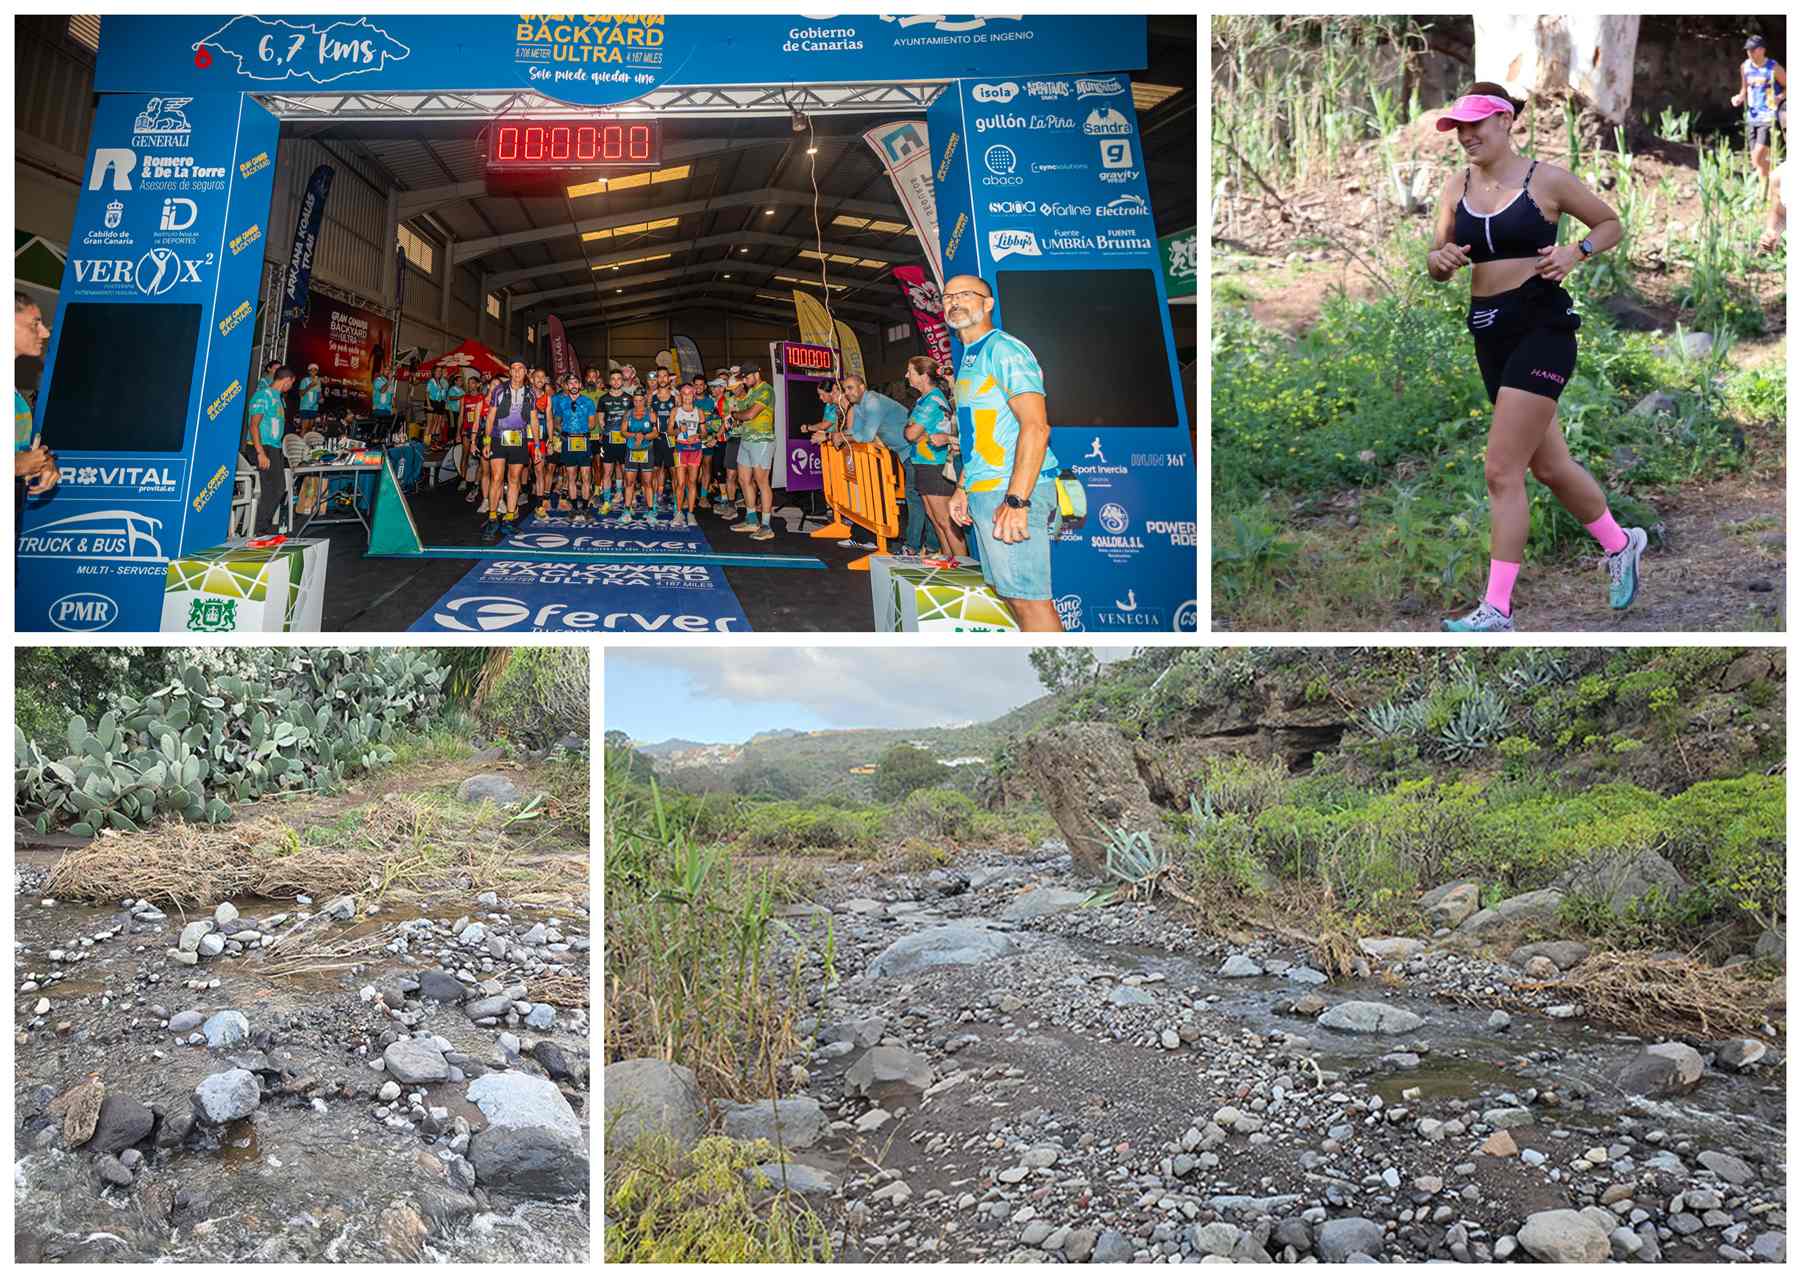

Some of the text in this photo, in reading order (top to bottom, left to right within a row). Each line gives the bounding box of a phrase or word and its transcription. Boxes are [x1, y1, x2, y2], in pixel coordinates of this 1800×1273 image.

[516, 24, 664, 46] BACKYARD
[789, 27, 855, 39] Gobierno
[894, 31, 1033, 47] AYUNTAMIENTO DE INGENIO
[259, 33, 376, 65] 6,7 kms
[783, 39, 863, 51] de Canarias
[553, 44, 623, 63] ULTRA
[643, 53, 663, 64] MILES
[529, 66, 655, 85] Solo puede quedar uno
[980, 86, 1011, 98] isola
[976, 113, 1075, 132] gullón La Piña
[1085, 122, 1132, 134] Sandra
[131, 135, 190, 147] GENERALI
[499, 126, 649, 160] 00:00:00
[143, 156, 194, 167] Romero
[141, 167, 225, 178] & De La Torre
[1099, 170, 1140, 182] gravity
[139, 179, 225, 192] Asesores de seguros
[982, 176, 1023, 185] abaco
[1051, 203, 1091, 216] farline
[1096, 206, 1150, 216] Electrolit
[287, 192, 316, 300] ARKANA KOALAS
[993, 233, 1032, 250] Libby's
[1042, 235, 1095, 250] UMBRÍA
[1096, 235, 1151, 249] Bruma
[57, 467, 176, 485] ROVITAL
[1072, 465, 1128, 475] Sport Inercia
[1146, 521, 1197, 535] POWER
[17, 537, 127, 552] TRUCK & BUS
[573, 536, 701, 549] ferver
[77, 566, 109, 575] MULTI
[117, 566, 168, 576] SERVICES
[493, 561, 708, 574] GRAN CANARIA
[484, 568, 711, 582] BACKYARD
[539, 576, 650, 587] ULTRA
[58, 601, 109, 622] PMR
[533, 602, 738, 632] ferver
[1099, 613, 1160, 626] VENECIA
